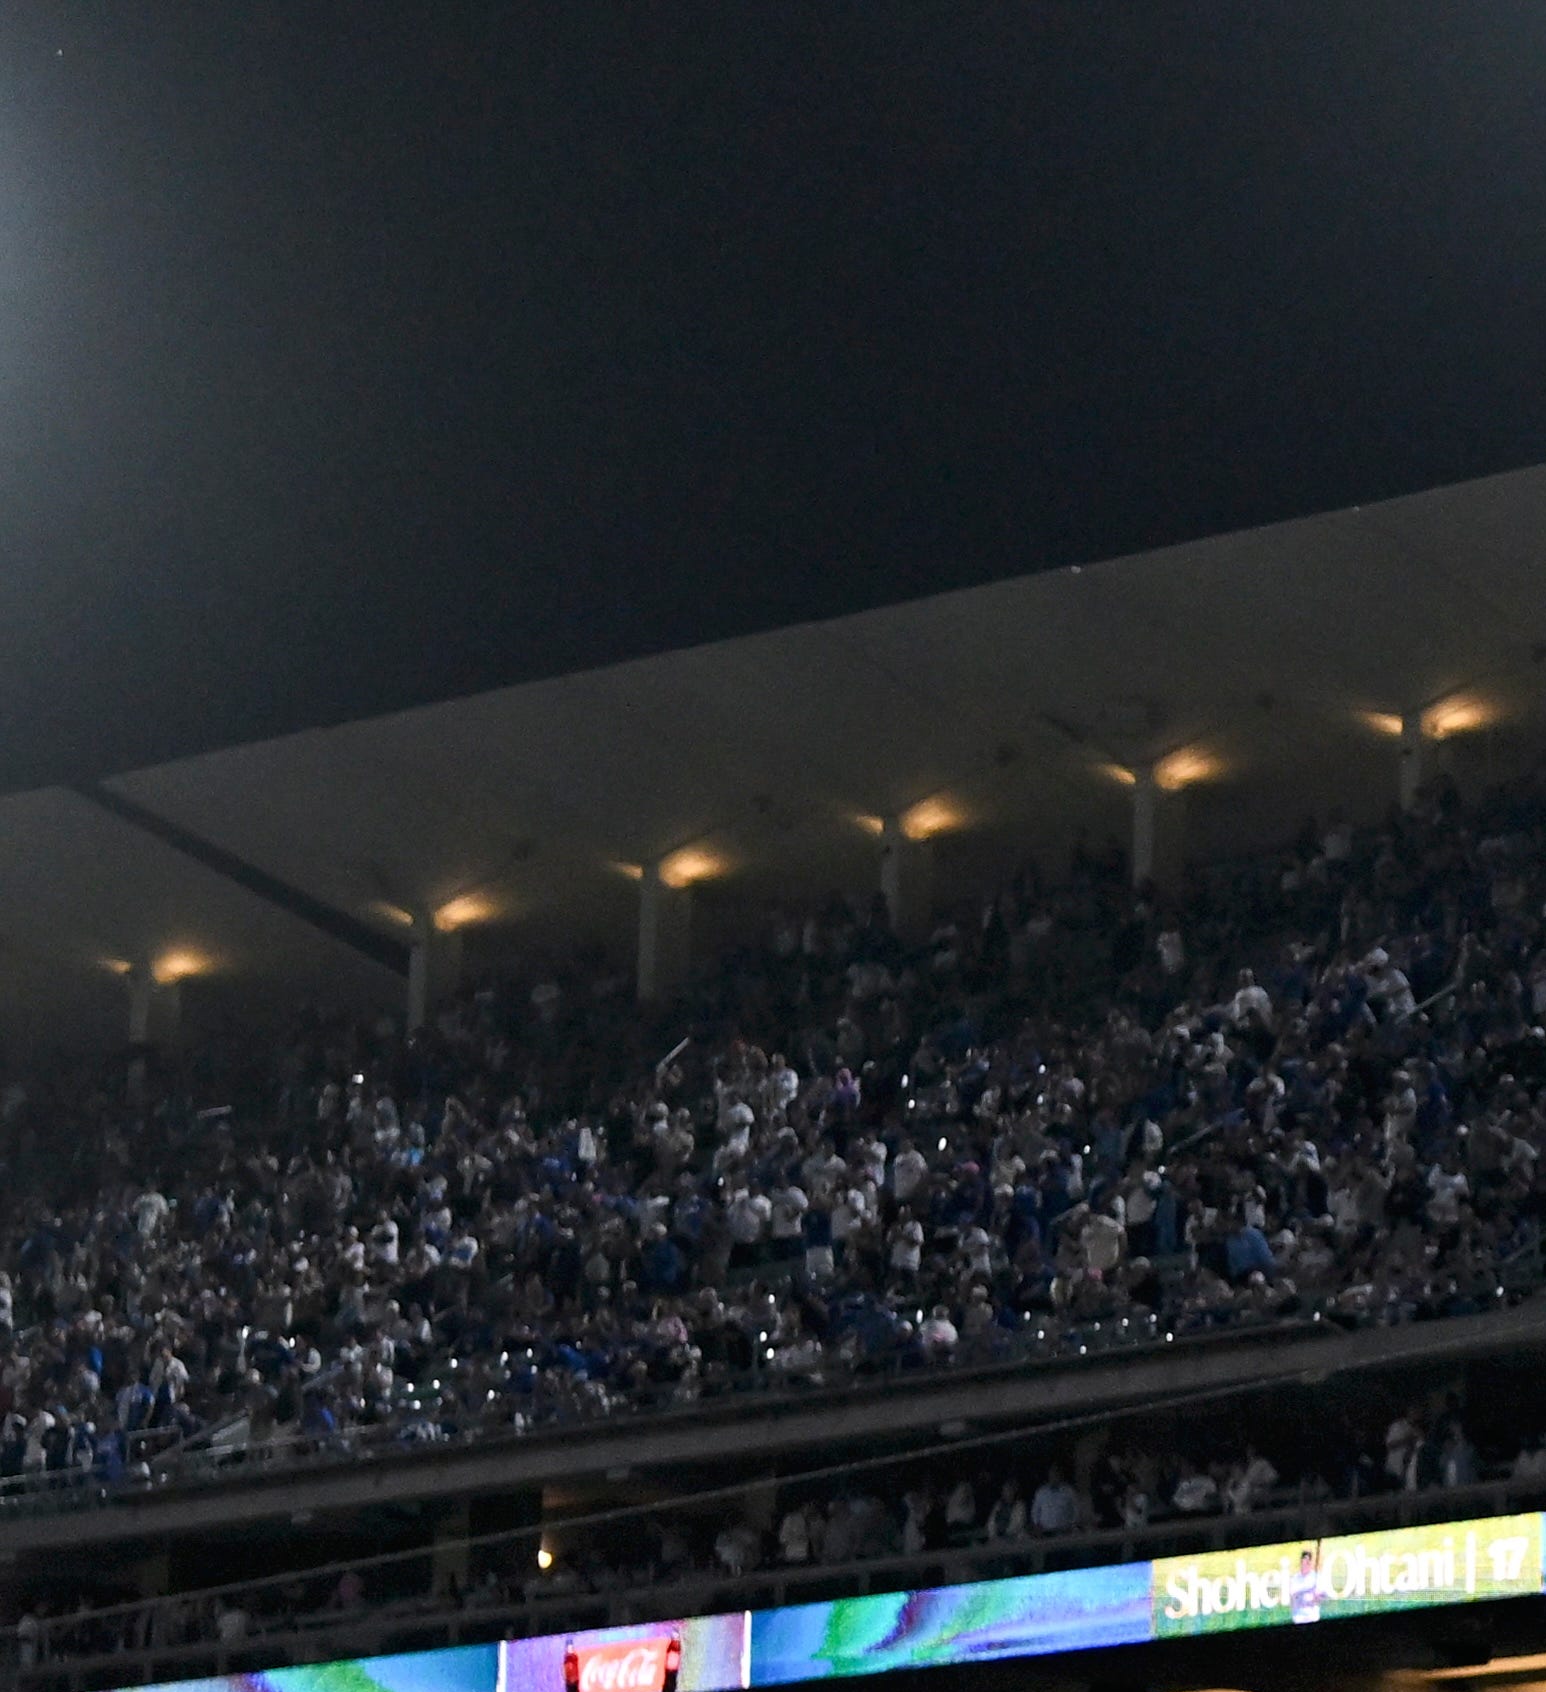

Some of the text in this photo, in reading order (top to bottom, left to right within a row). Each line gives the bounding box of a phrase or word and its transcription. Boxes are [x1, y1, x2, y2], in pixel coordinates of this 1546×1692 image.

[1164, 1536, 1529, 1620] Shohei Ohtani 17
